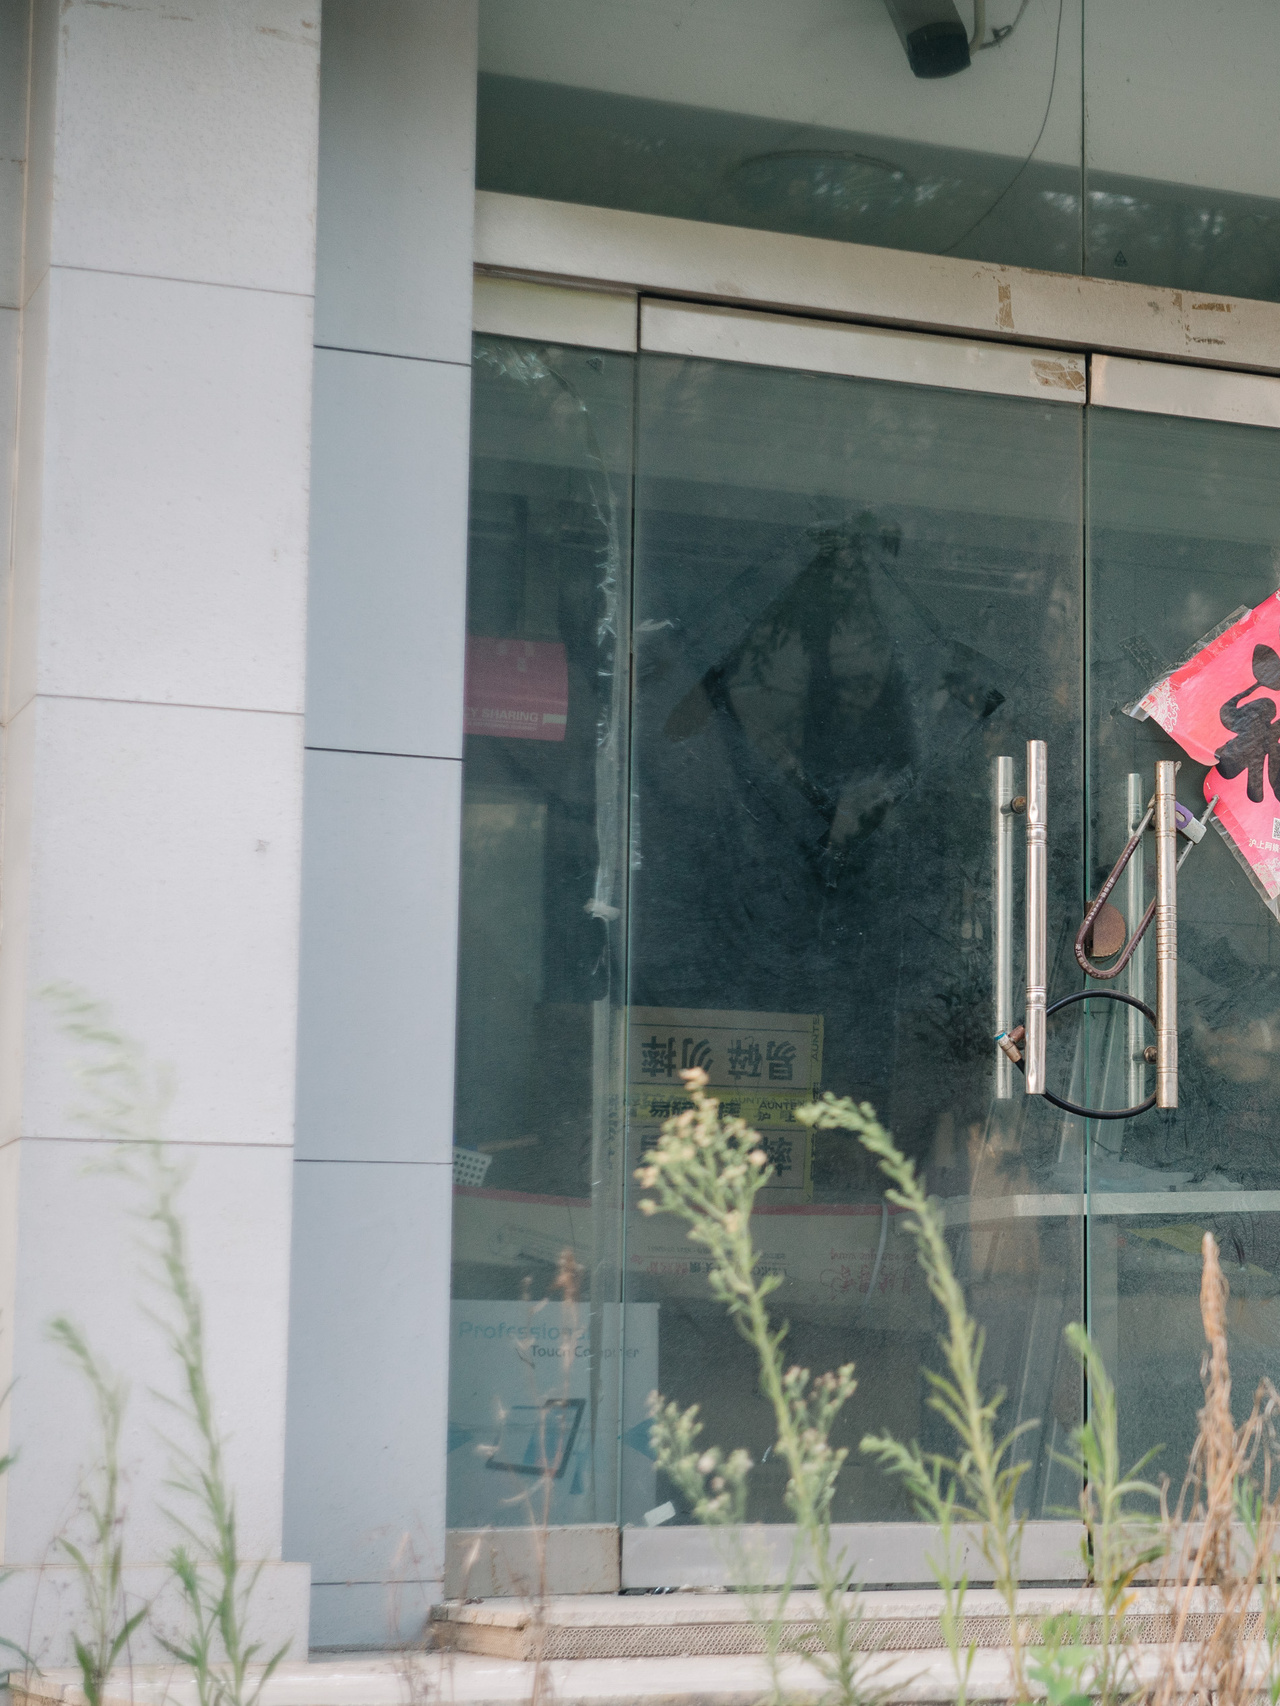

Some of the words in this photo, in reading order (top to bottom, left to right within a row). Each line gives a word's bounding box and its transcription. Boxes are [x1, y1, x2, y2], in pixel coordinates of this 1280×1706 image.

[482, 708, 539, 723] SHARING
[641, 1035, 714, 1078] 勿摔
[727, 1039, 797, 1081] 易碎
[574, 1345, 640, 1360] Coper
